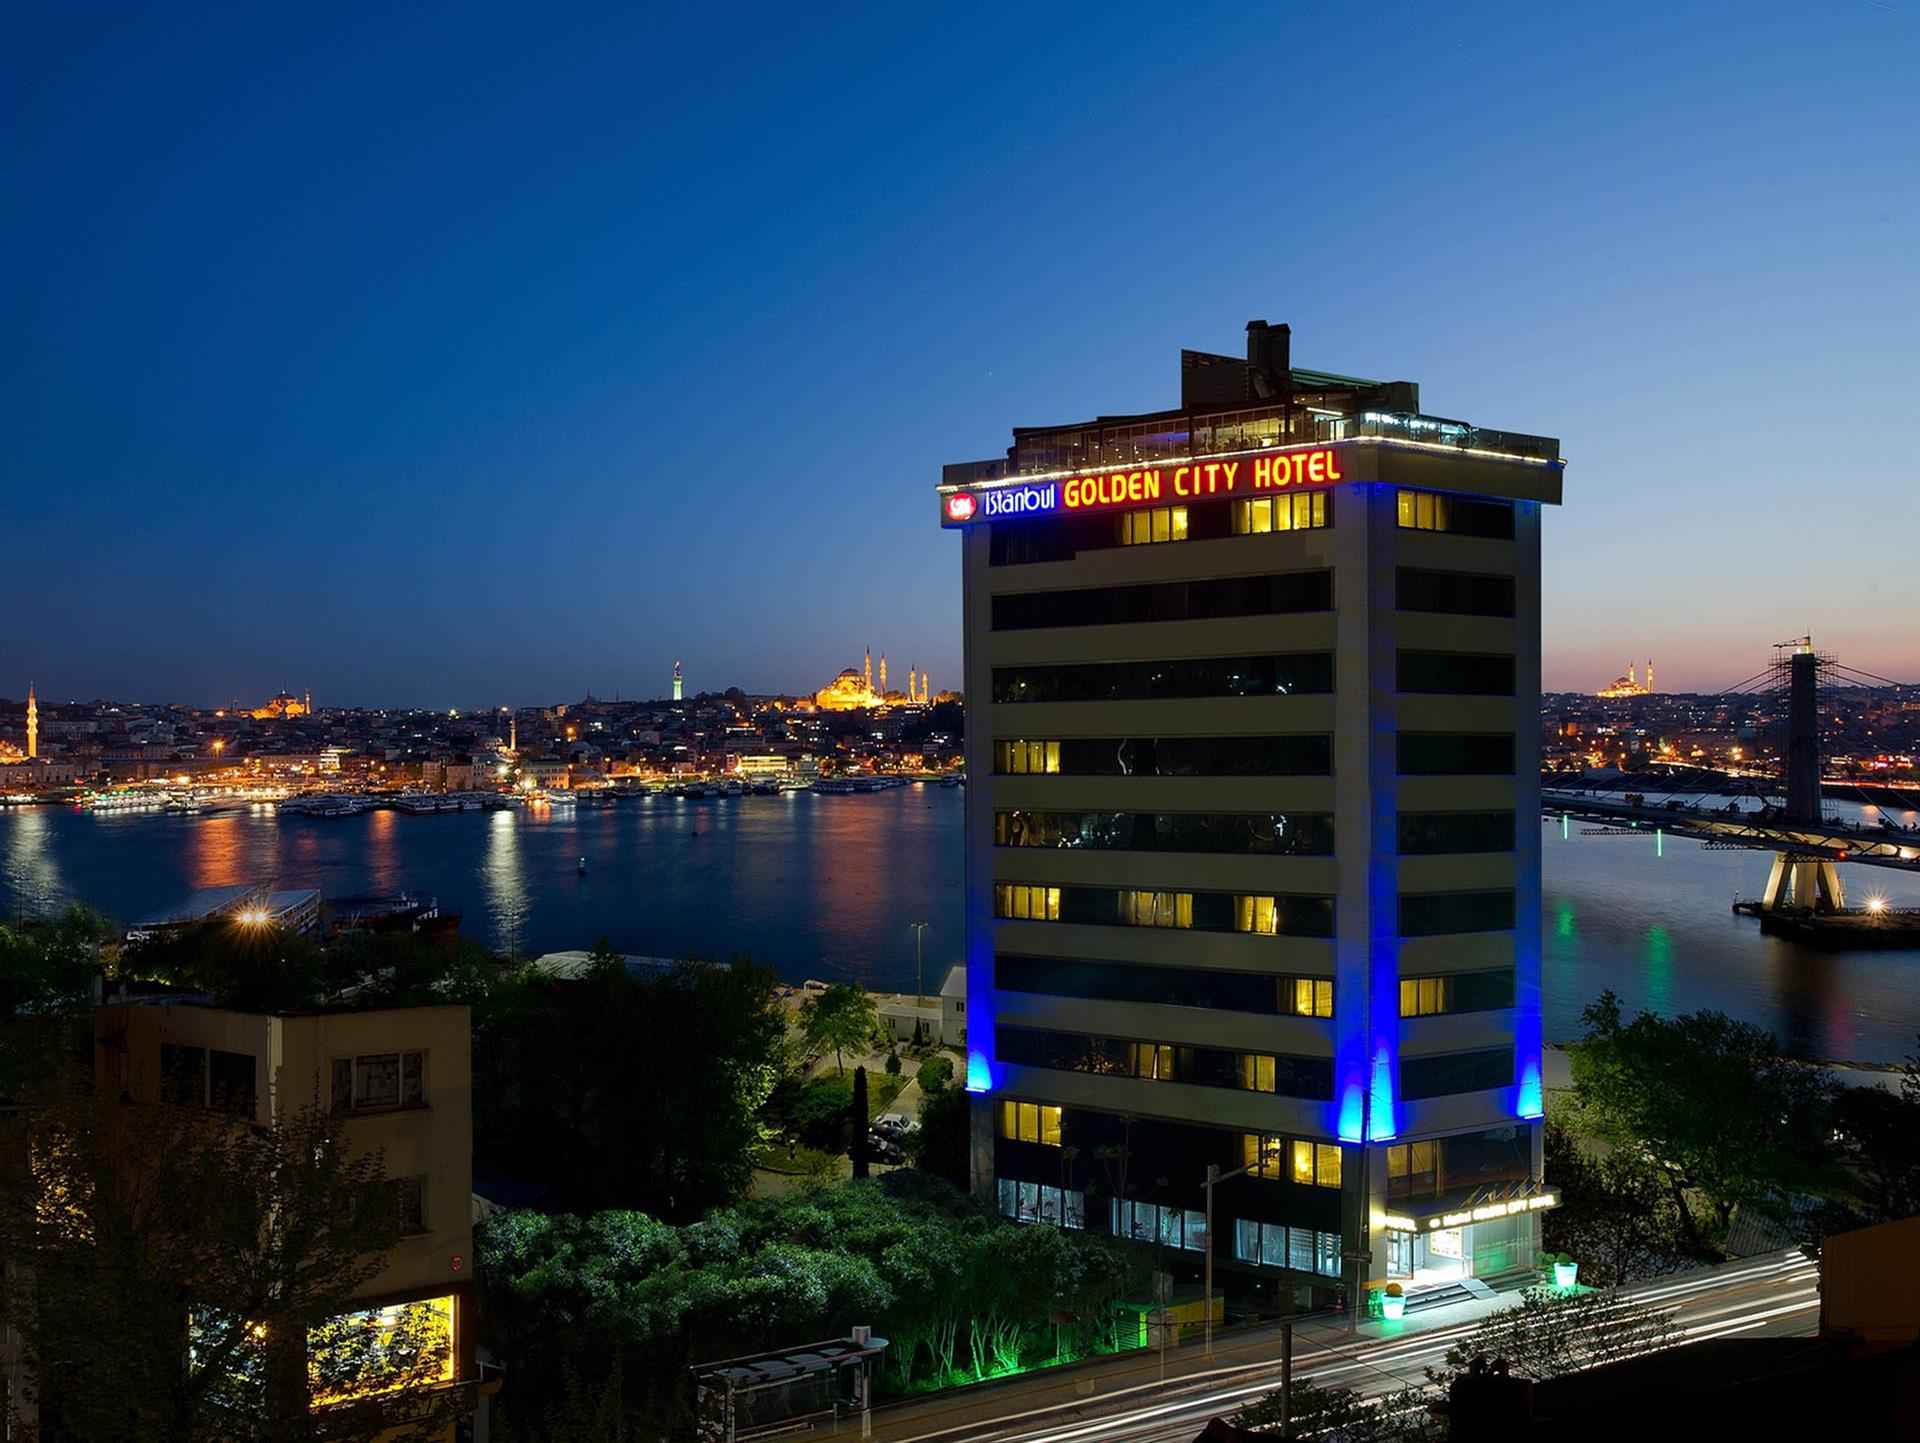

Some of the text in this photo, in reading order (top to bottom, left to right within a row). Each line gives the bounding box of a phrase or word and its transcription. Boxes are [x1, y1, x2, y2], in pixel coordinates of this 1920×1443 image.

[1063, 470, 1161, 508] GOLDEN
[1173, 462, 1239, 497] CITY
[1254, 450, 1341, 488] HOTEL
